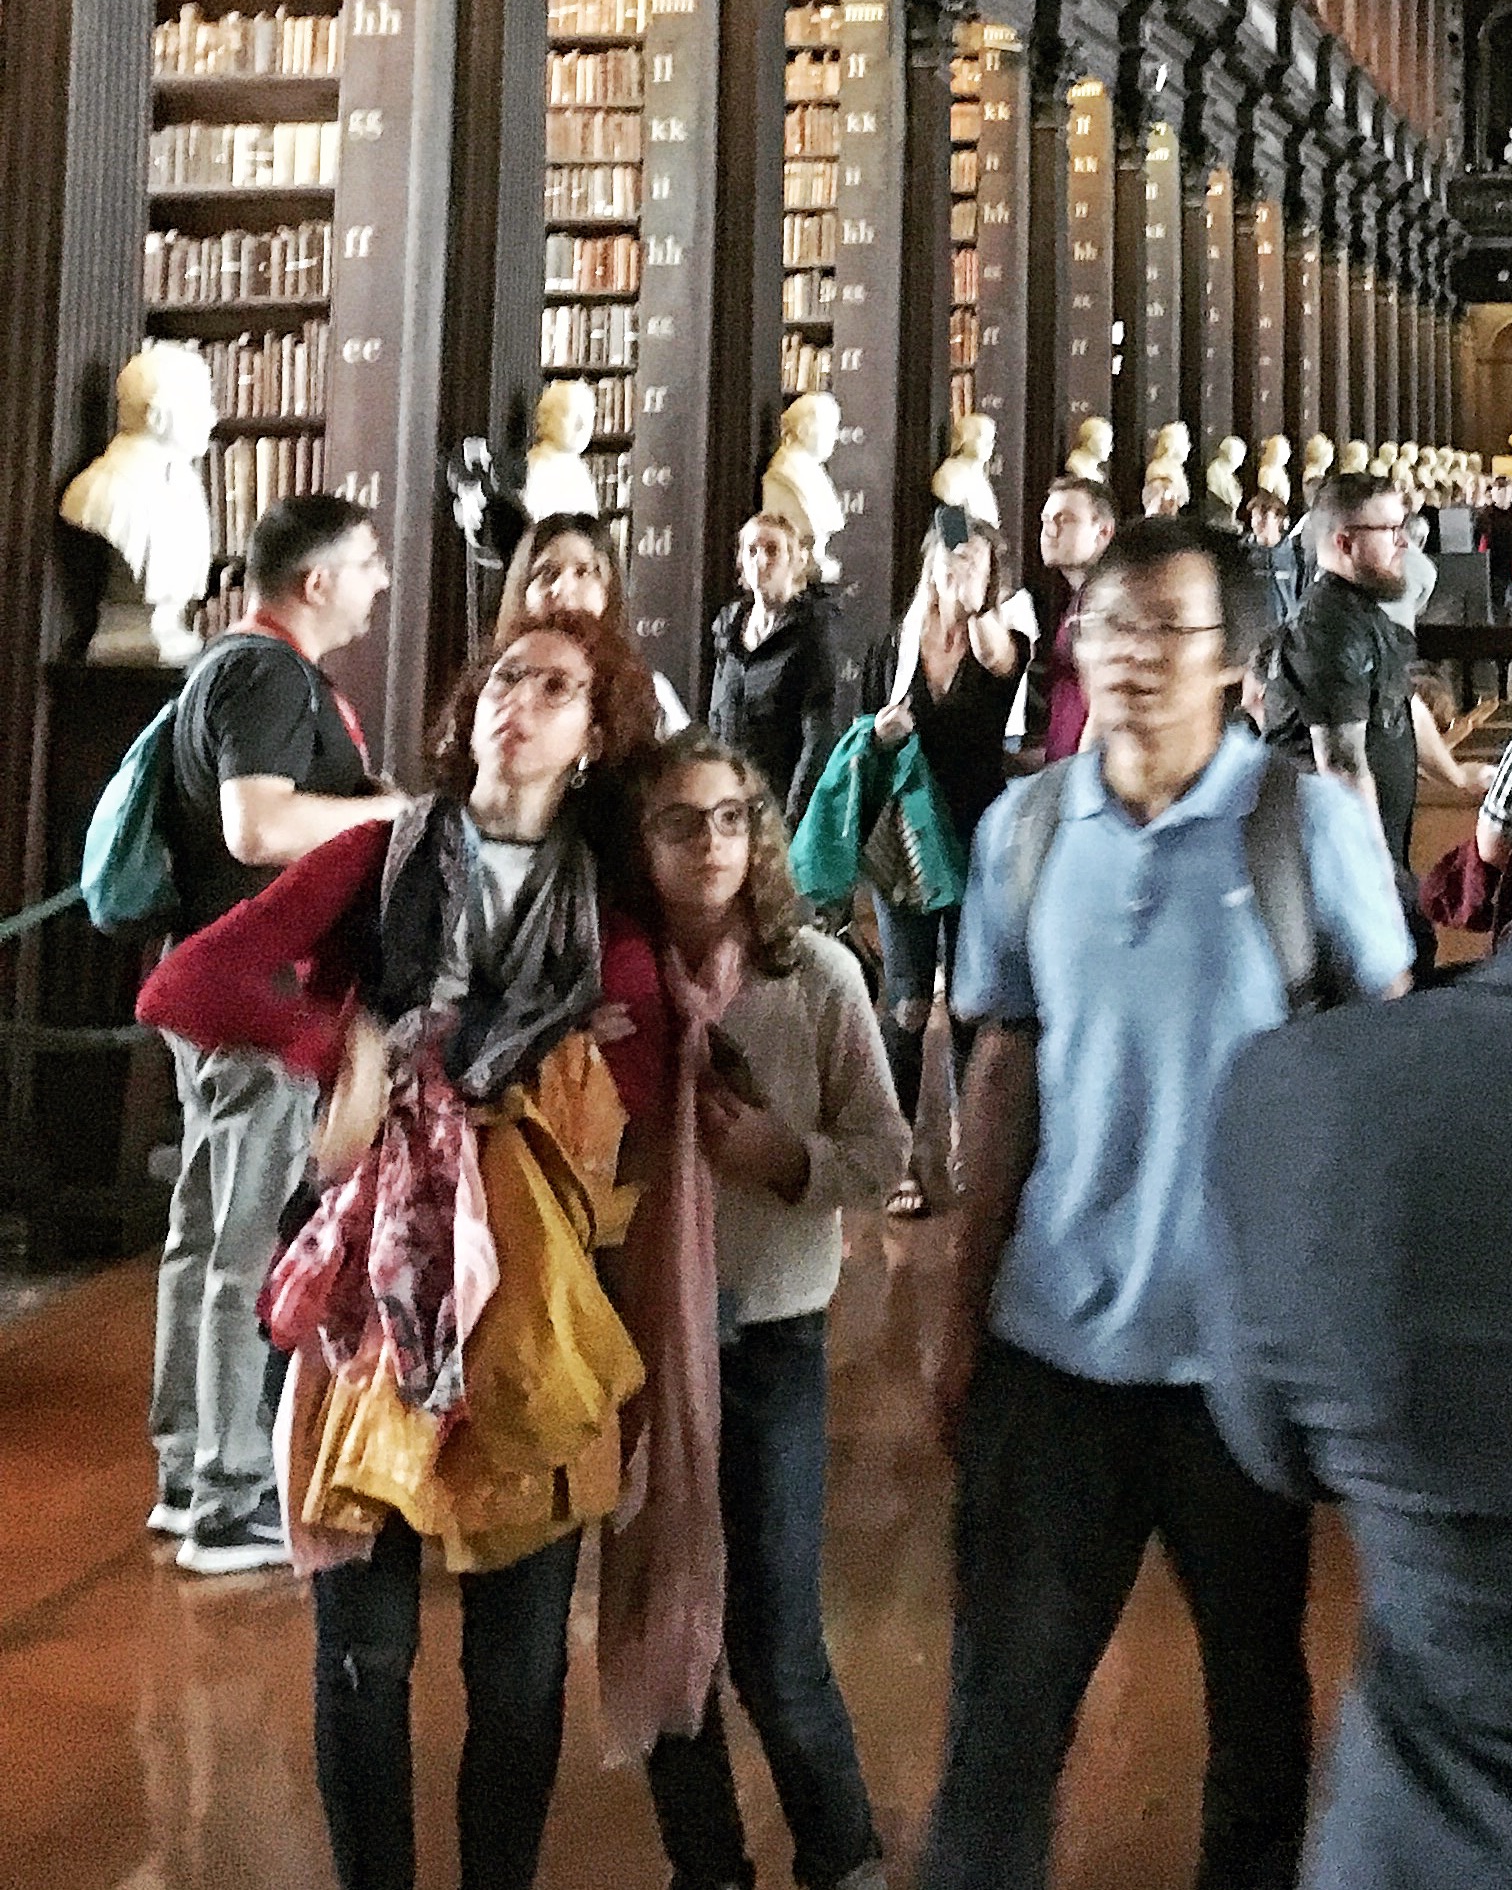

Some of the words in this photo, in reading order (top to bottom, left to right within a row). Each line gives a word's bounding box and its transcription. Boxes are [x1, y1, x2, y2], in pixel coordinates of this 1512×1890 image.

[651, 115, 688, 142] kk
[846, 111, 877, 133] kk
[344, 224, 374, 259] ff
[842, 218, 875, 245] hh
[648, 233, 682, 265] hh
[637, 525, 673, 558] dd
